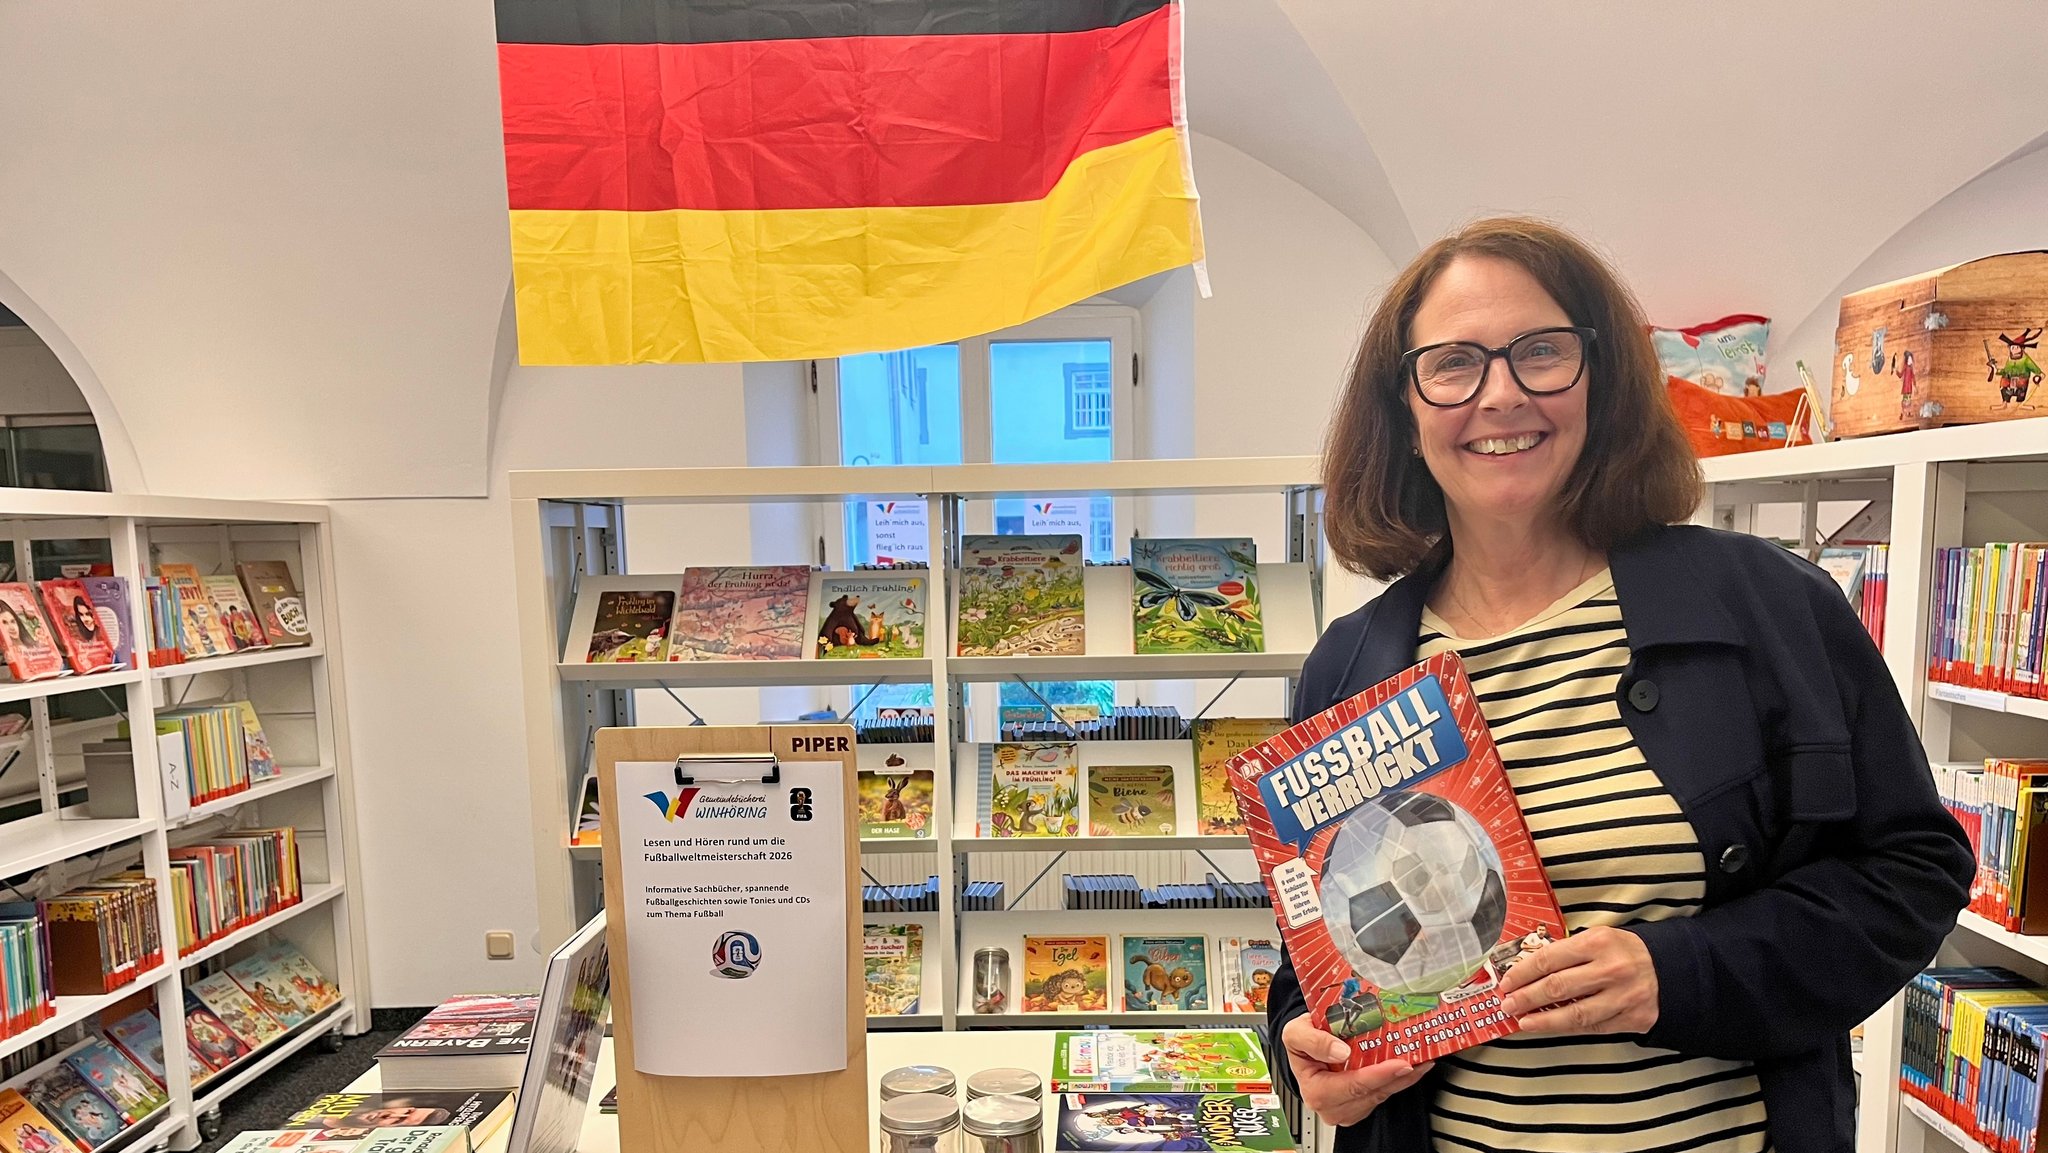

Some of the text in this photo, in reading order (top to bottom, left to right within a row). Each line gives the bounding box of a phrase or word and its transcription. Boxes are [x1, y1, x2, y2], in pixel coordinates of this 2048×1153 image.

[742, 571, 777, 581] Hurra,
[707, 580, 722, 589] der
[831, 583, 868, 593] Endlich
[791, 736, 850, 752] PIPER
[1227, 739, 1245, 748] Das
[1269, 687, 1441, 809] FUSSBALL
[1240, 759, 1263, 780] DK
[1022, 775, 1057, 783] FRÜHLING!
[1291, 728, 1441, 832] VERRÜCKT
[1113, 786, 1148, 797] Biene
[699, 794, 767, 804] Gemeindebücherei
[695, 804, 768, 819] WINHÖRING
[871, 827, 901, 835] DER HASE
[643, 836, 786, 848] Lesen und Hören rund um die
[644, 851, 793, 862] Fußballweltmeisterschaft 2026
[1286, 876, 1296, 884] von
[645, 884, 789, 895] Informative Sachbücher, spannende
[646, 896, 811, 908] Fußballgeschichten sowie Tonies und CDs
[1293, 899, 1311, 910] führen
[664, 910, 692, 918] Thema
[693, 909, 724, 918] Fußball
[1051, 946, 1079, 967] Igel
[1358, 995, 1502, 1052] Was du garantiert noch
[393, 1038, 492, 1048] BAYERN
[1394, 1040, 1421, 1057] über
[1424, 1021, 1471, 1045] Fußball
[318, 1093, 372, 1119] MUT
[1200, 1099, 1242, 1144] MONSTER
[1233, 1107, 1272, 1136] KICKER
